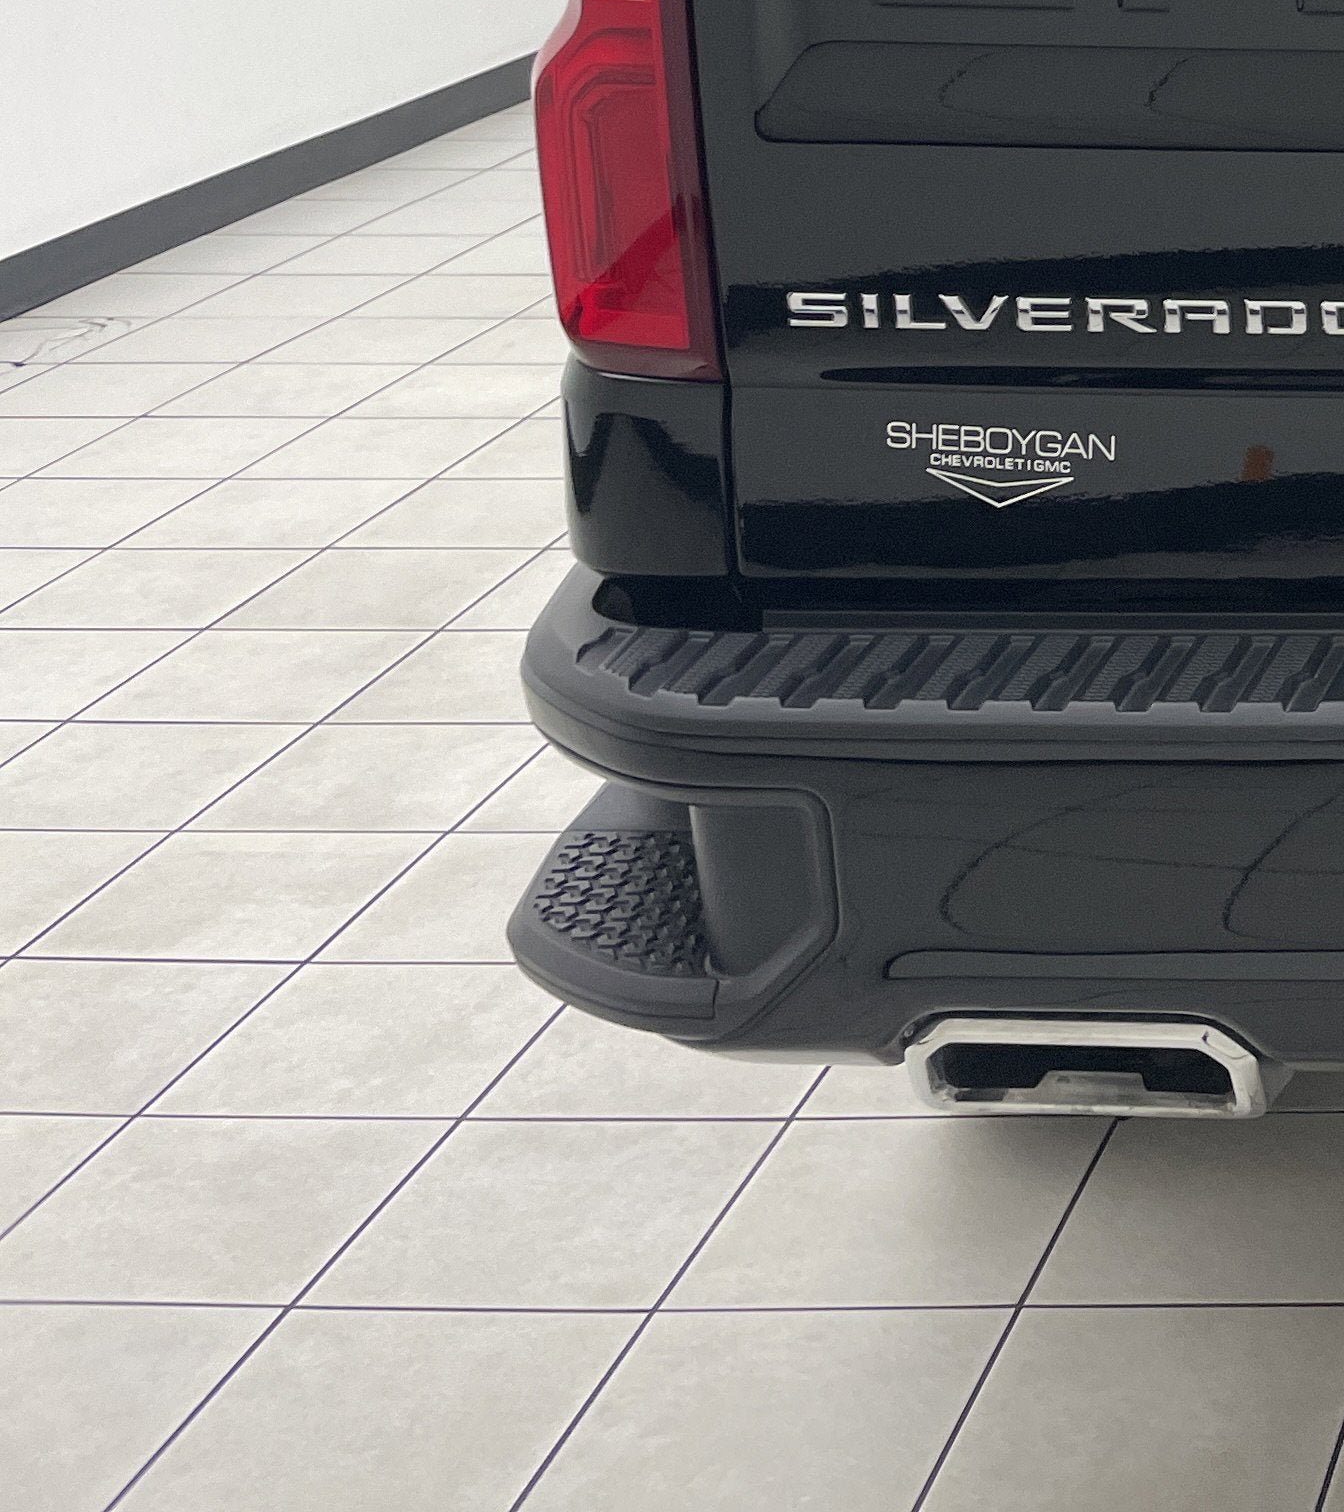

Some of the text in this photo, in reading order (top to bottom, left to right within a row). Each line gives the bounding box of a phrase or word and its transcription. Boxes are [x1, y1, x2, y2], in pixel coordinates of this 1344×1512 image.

[886, 420, 1117, 462] SHEBOYGAN
[929, 452, 1072, 474] CHEVROLET GMC
